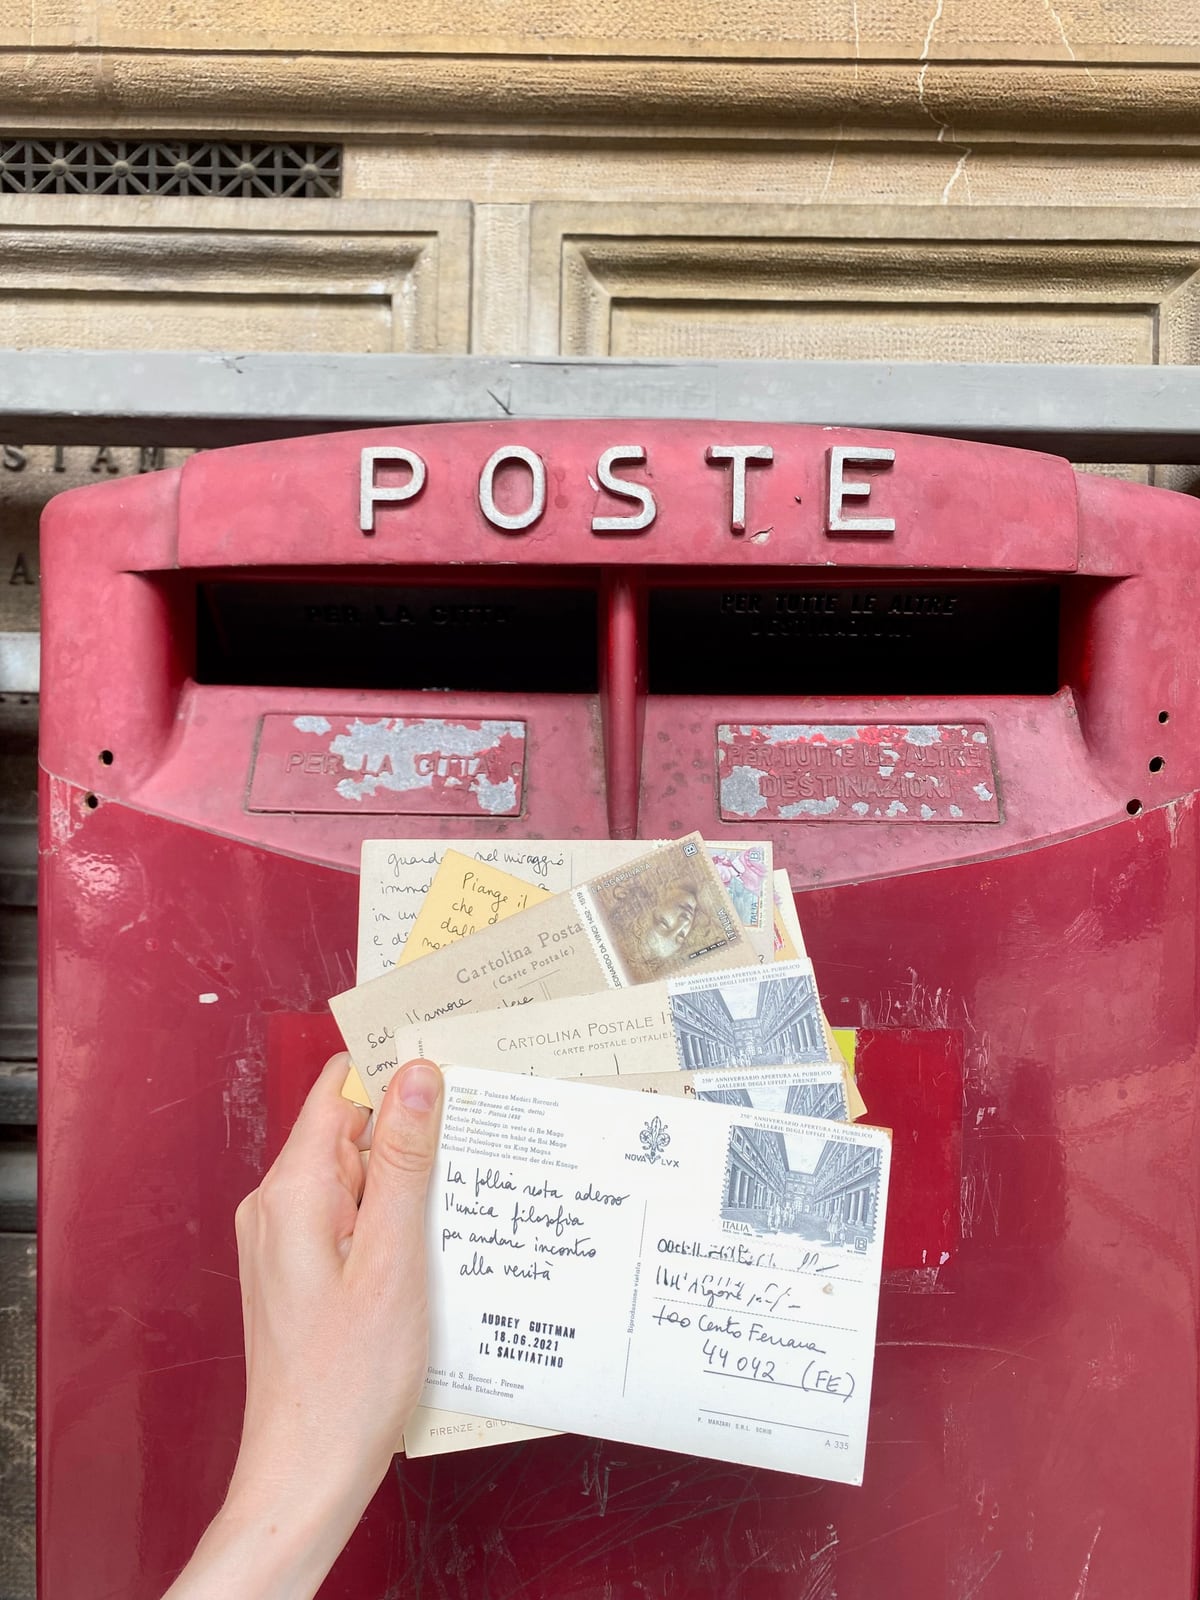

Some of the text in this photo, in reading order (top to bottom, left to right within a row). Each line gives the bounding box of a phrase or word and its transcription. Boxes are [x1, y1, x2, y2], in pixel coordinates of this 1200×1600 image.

[360, 445, 896, 534] POSTE
[286, 751, 341, 776] PER
[361, 753, 394, 777] LA
[727, 744, 773, 768] PER
[779, 744, 859, 768] TUTTE
[904, 743, 984, 769] ALTRE
[451, 897, 474, 917] che
[717, 906, 738, 941] ITALIA
[456, 945, 533, 984] Cartolina
[496, 1015, 654, 1052] CARTOLINA POSTALE
[588, 1038, 628, 1052] POSTALE
[450, 1085, 479, 1096] FIRENZE
[446, 1160, 467, 1185] La
[624, 1152, 680, 1169] NOVA LVX
[511, 1201, 585, 1238] filosofia
[721, 1220, 750, 1233] ITALIA
[856, 1237, 867, 1250] B
[459, 1251, 494, 1277] alla
[481, 1311, 577, 1340] AUDREY GUTTMAN
[698, 1313, 743, 1339] Cento
[494, 1329, 560, 1352] 18.06.2021
[479, 1341, 565, 1369] IL SALVIATINO
[449, 1370, 457, 1379] di
[800, 1359, 856, 1404] (FE)
[429, 1422, 474, 1438] FIRENZE
[824, 1439, 850, 1451] A 335
